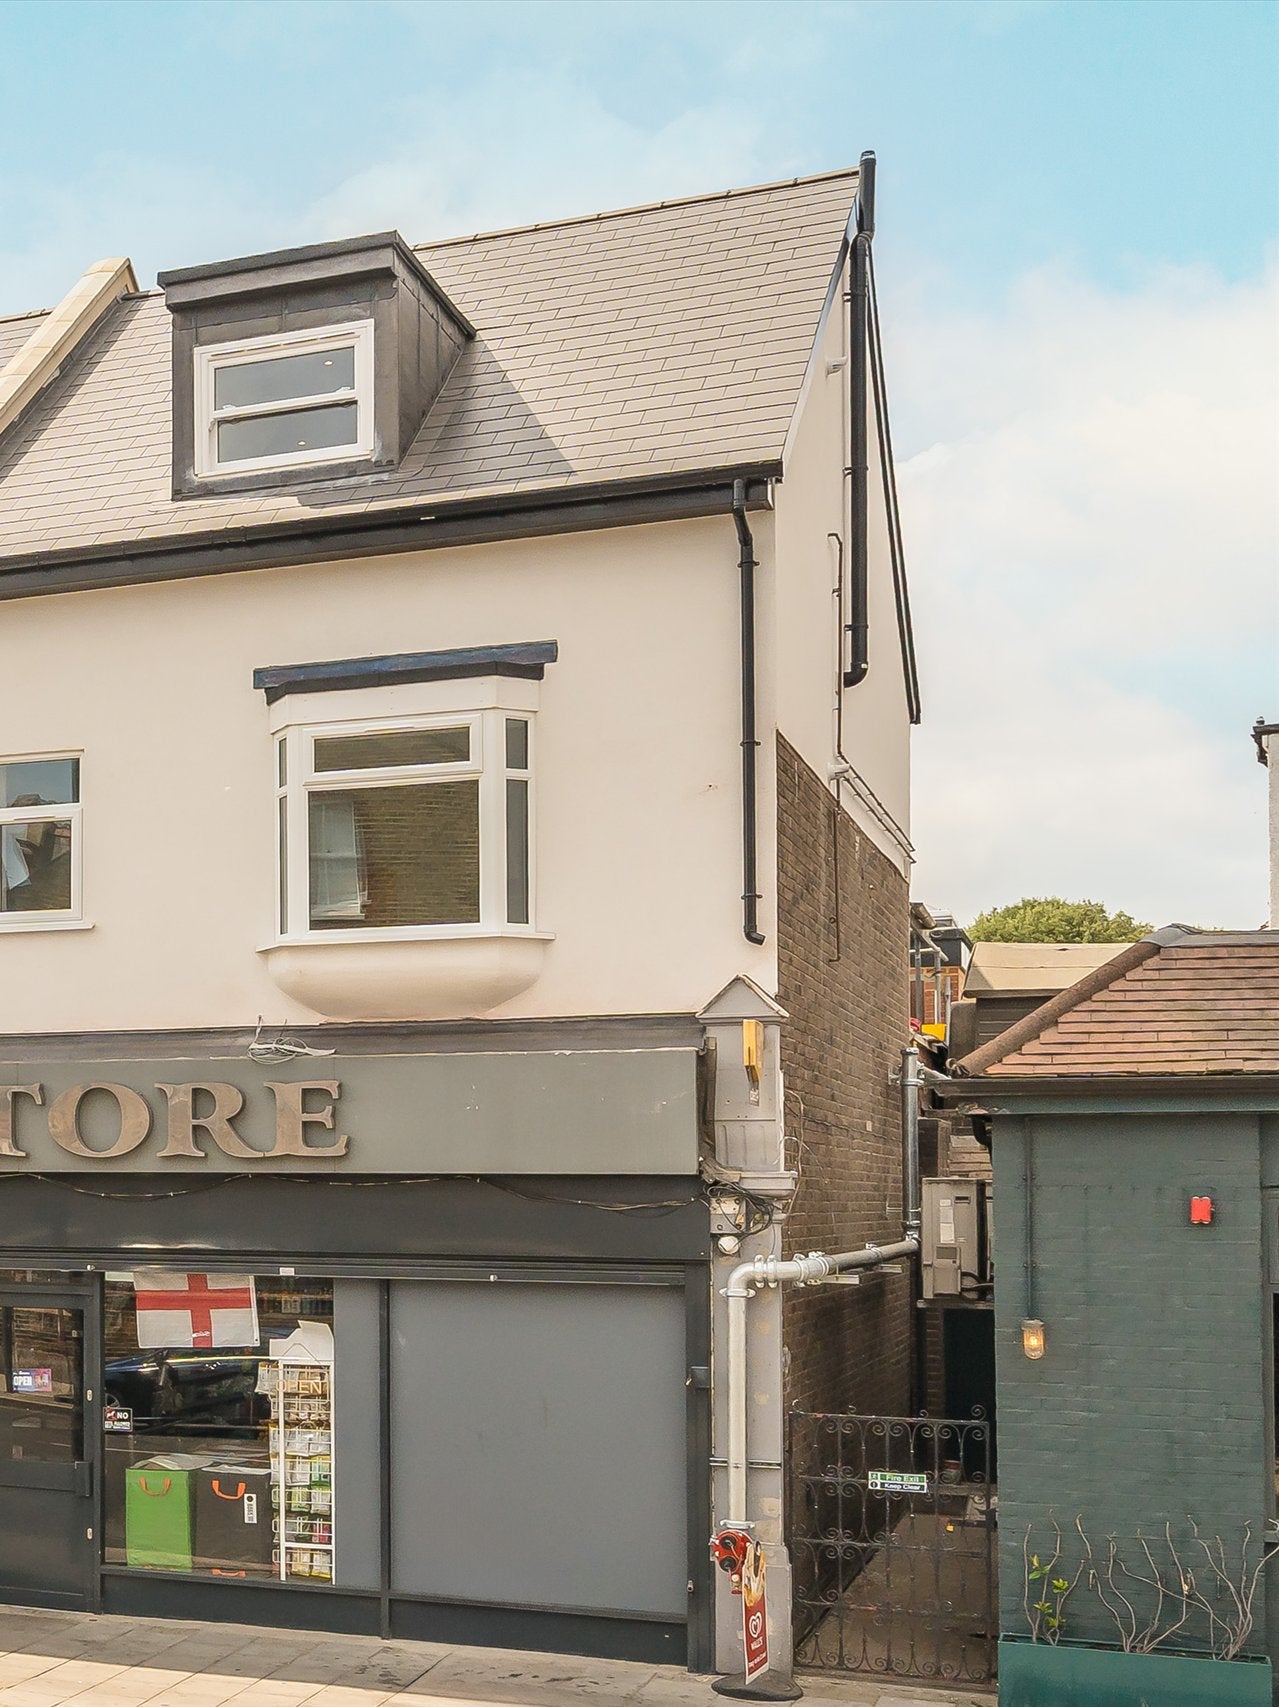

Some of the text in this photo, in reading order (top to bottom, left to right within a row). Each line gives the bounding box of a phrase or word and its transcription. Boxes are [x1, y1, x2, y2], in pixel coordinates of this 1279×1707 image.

[13, 1375, 33, 1386] OPEN
[117, 1411, 129, 1420] NO
[886, 1474, 919, 1483] Fire Exit
